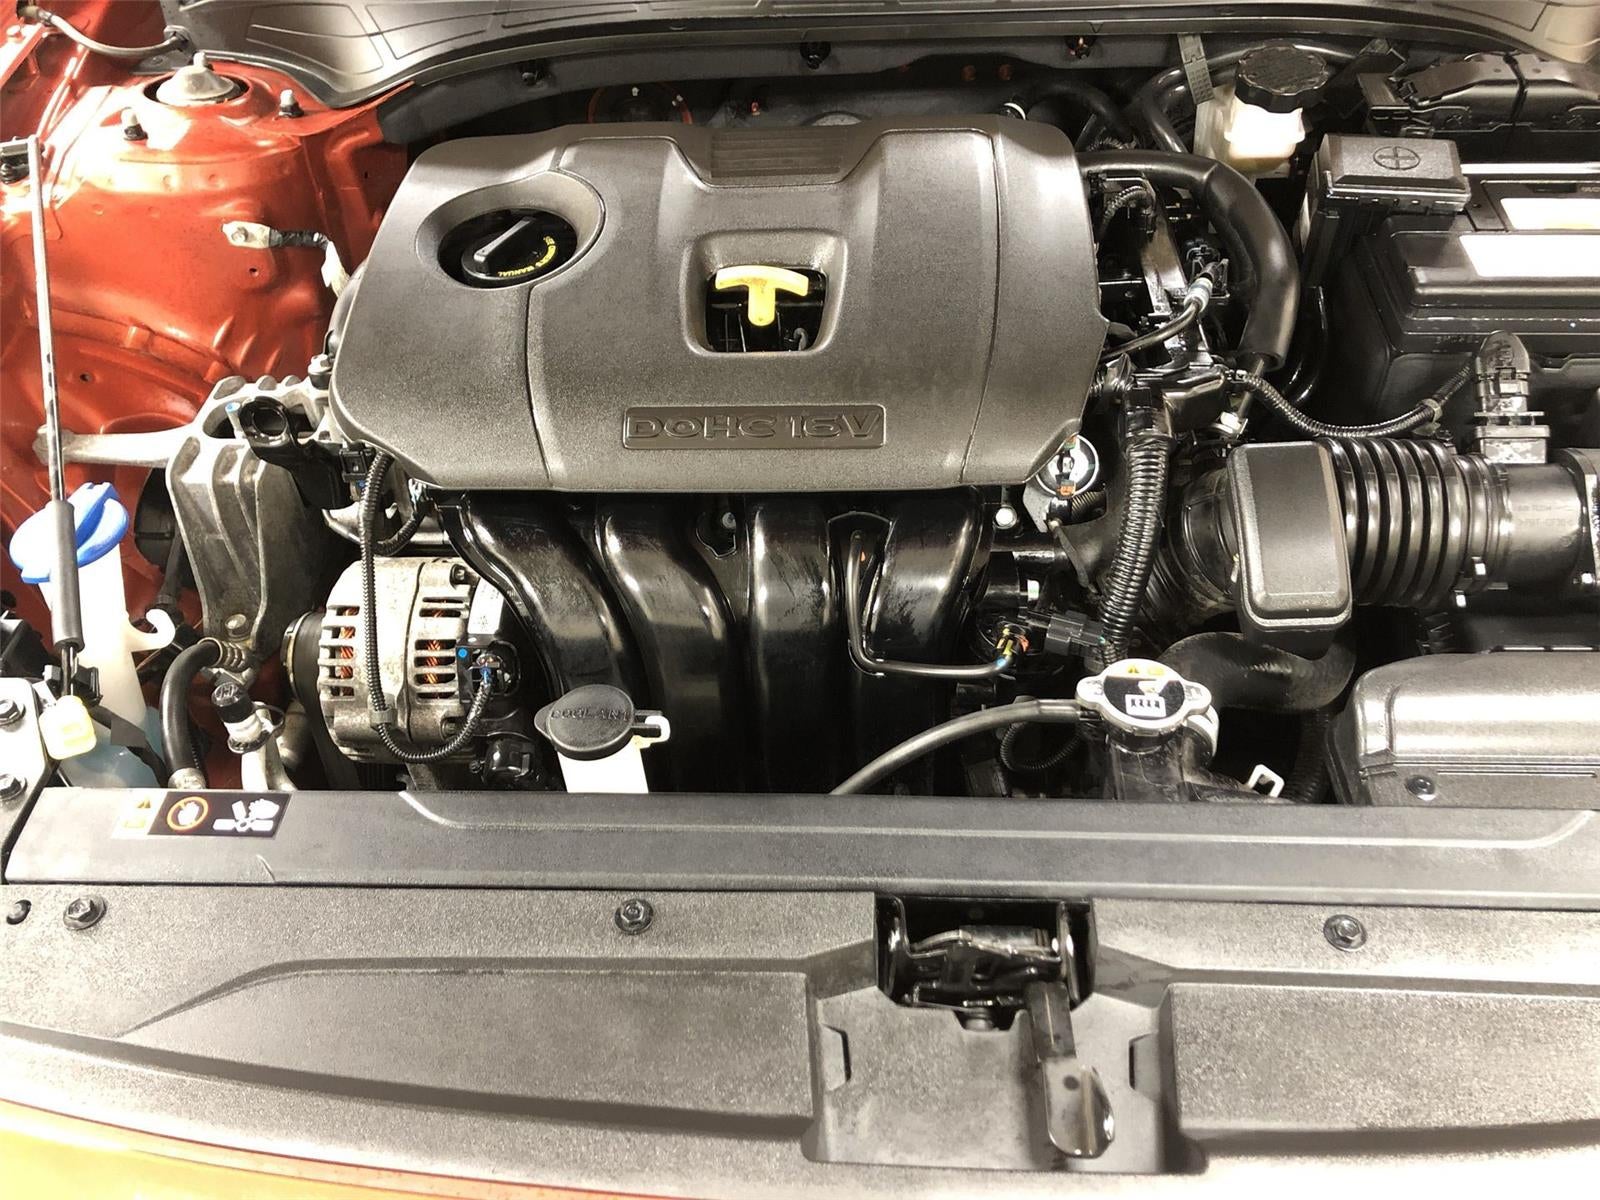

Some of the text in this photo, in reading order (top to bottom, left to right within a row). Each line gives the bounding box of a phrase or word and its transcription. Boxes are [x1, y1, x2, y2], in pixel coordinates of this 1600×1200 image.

[626, 413, 880, 439] DOHC 16V
[550, 705, 631, 722] COOLANT
